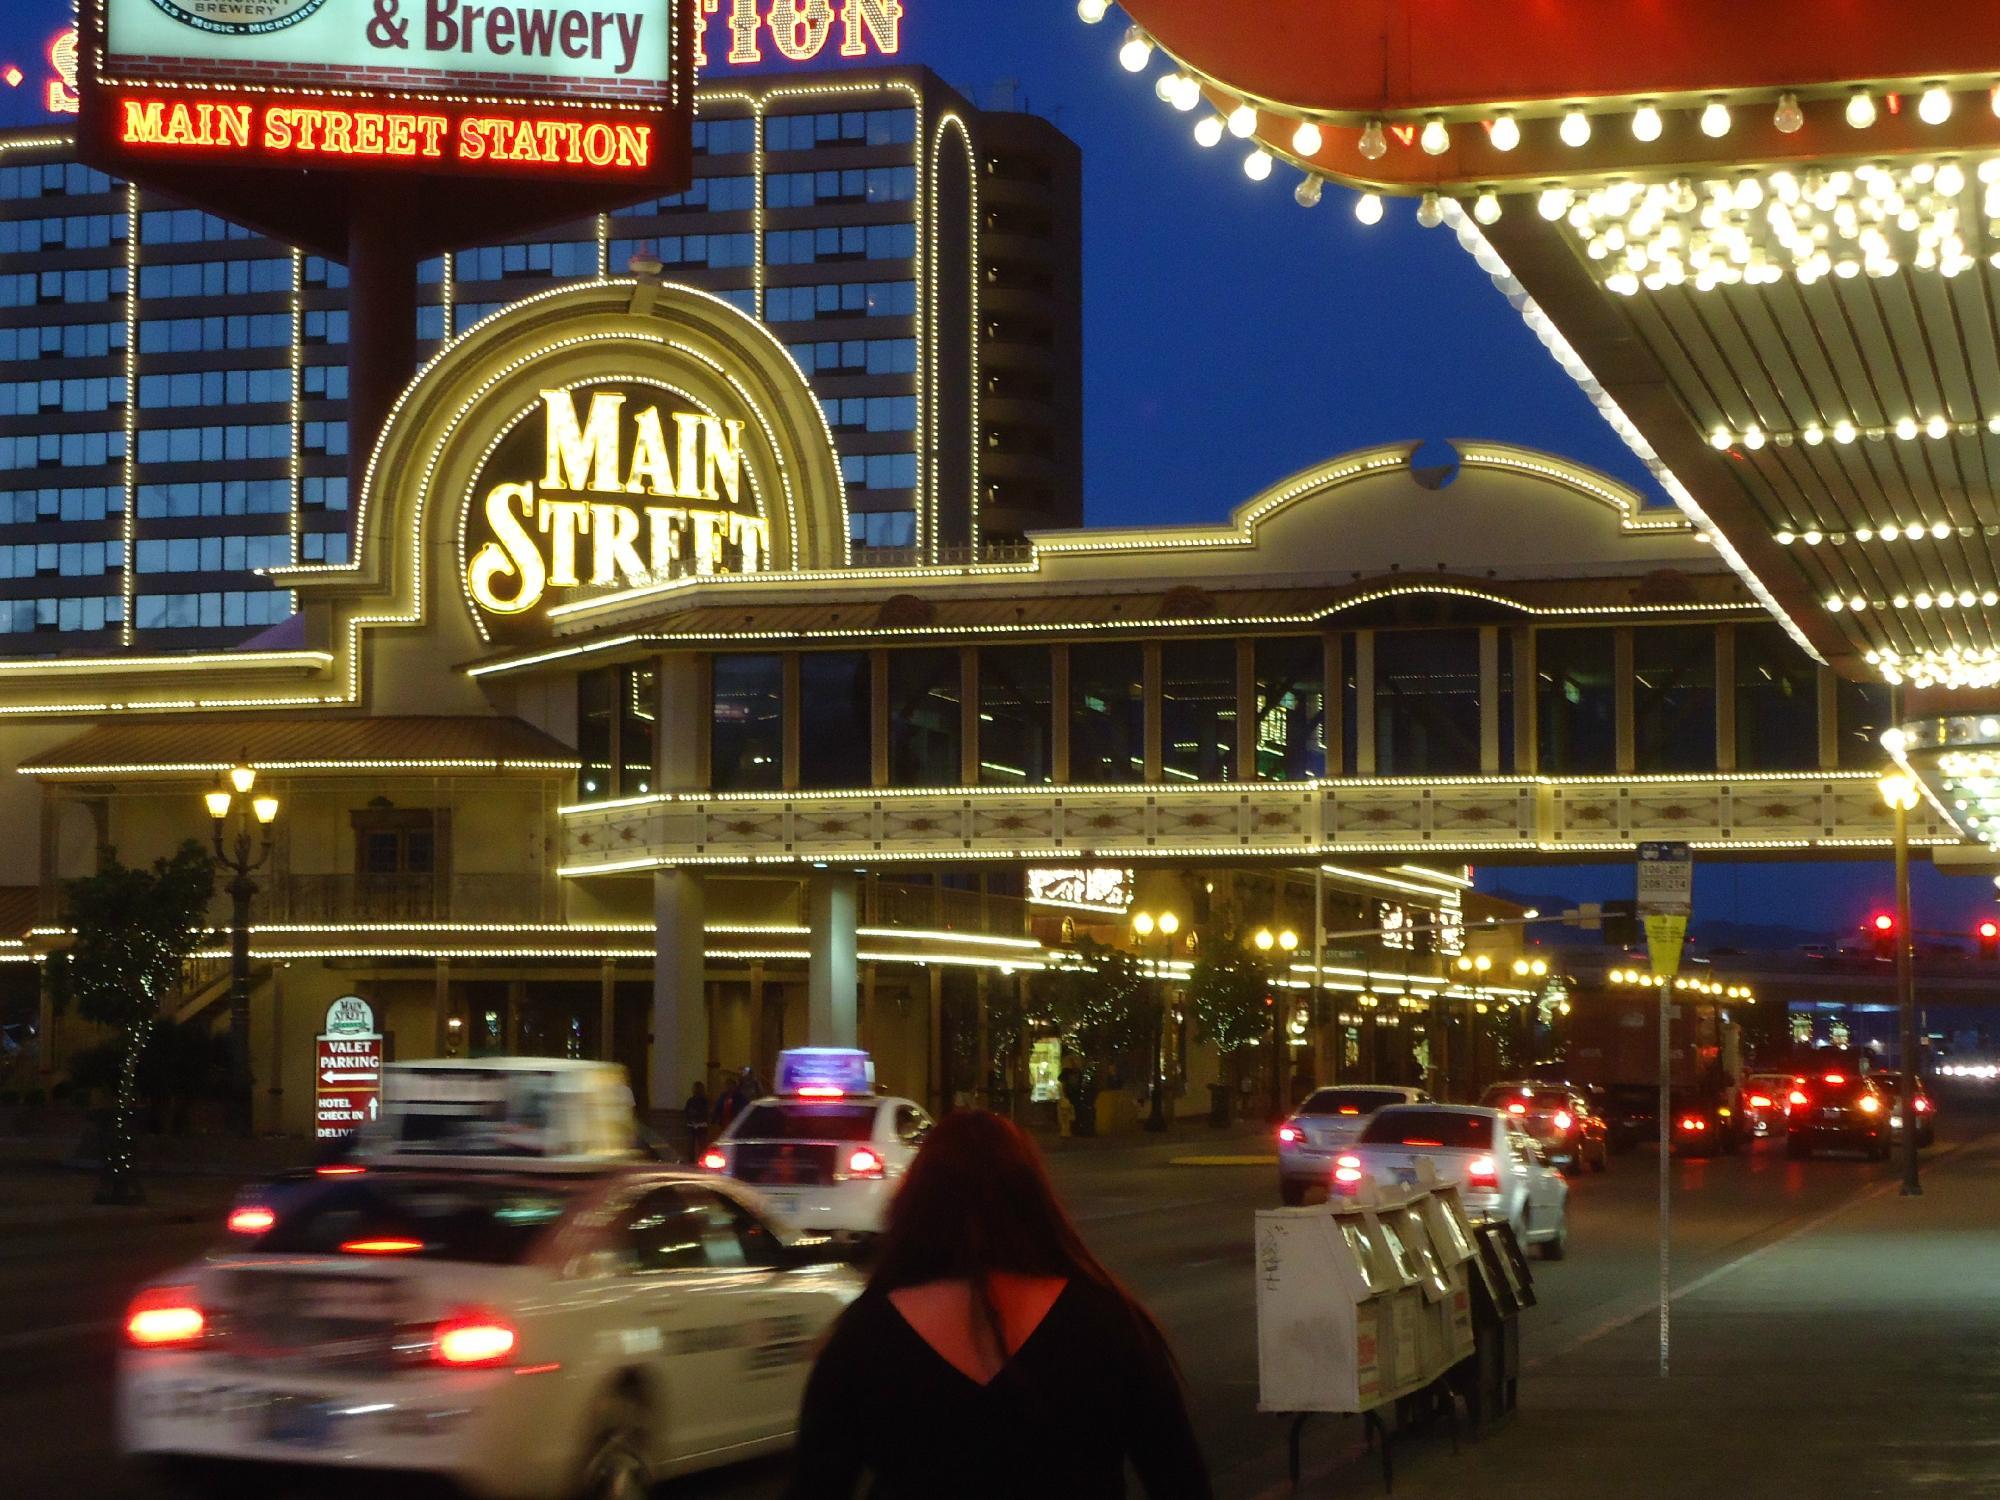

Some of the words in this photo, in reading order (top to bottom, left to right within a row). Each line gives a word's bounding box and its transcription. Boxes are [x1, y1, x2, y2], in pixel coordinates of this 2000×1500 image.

[195, 3, 276, 15] BREWERY
[366, 0, 409, 49] &
[426, 0, 644, 74] Brewery
[124, 101, 252, 147] MAIN
[264, 107, 447, 156] STREET
[459, 117, 650, 167] STATION
[539, 389, 745, 503] MAIN
[468, 481, 769, 614] STREET
[329, 1042, 372, 1053] VALET
[320, 1056, 379, 1069] PARKING
[318, 1098, 352, 1108] HOTEL
[317, 1111, 351, 1121] CHECK
[352, 1111, 364, 1120] IN
